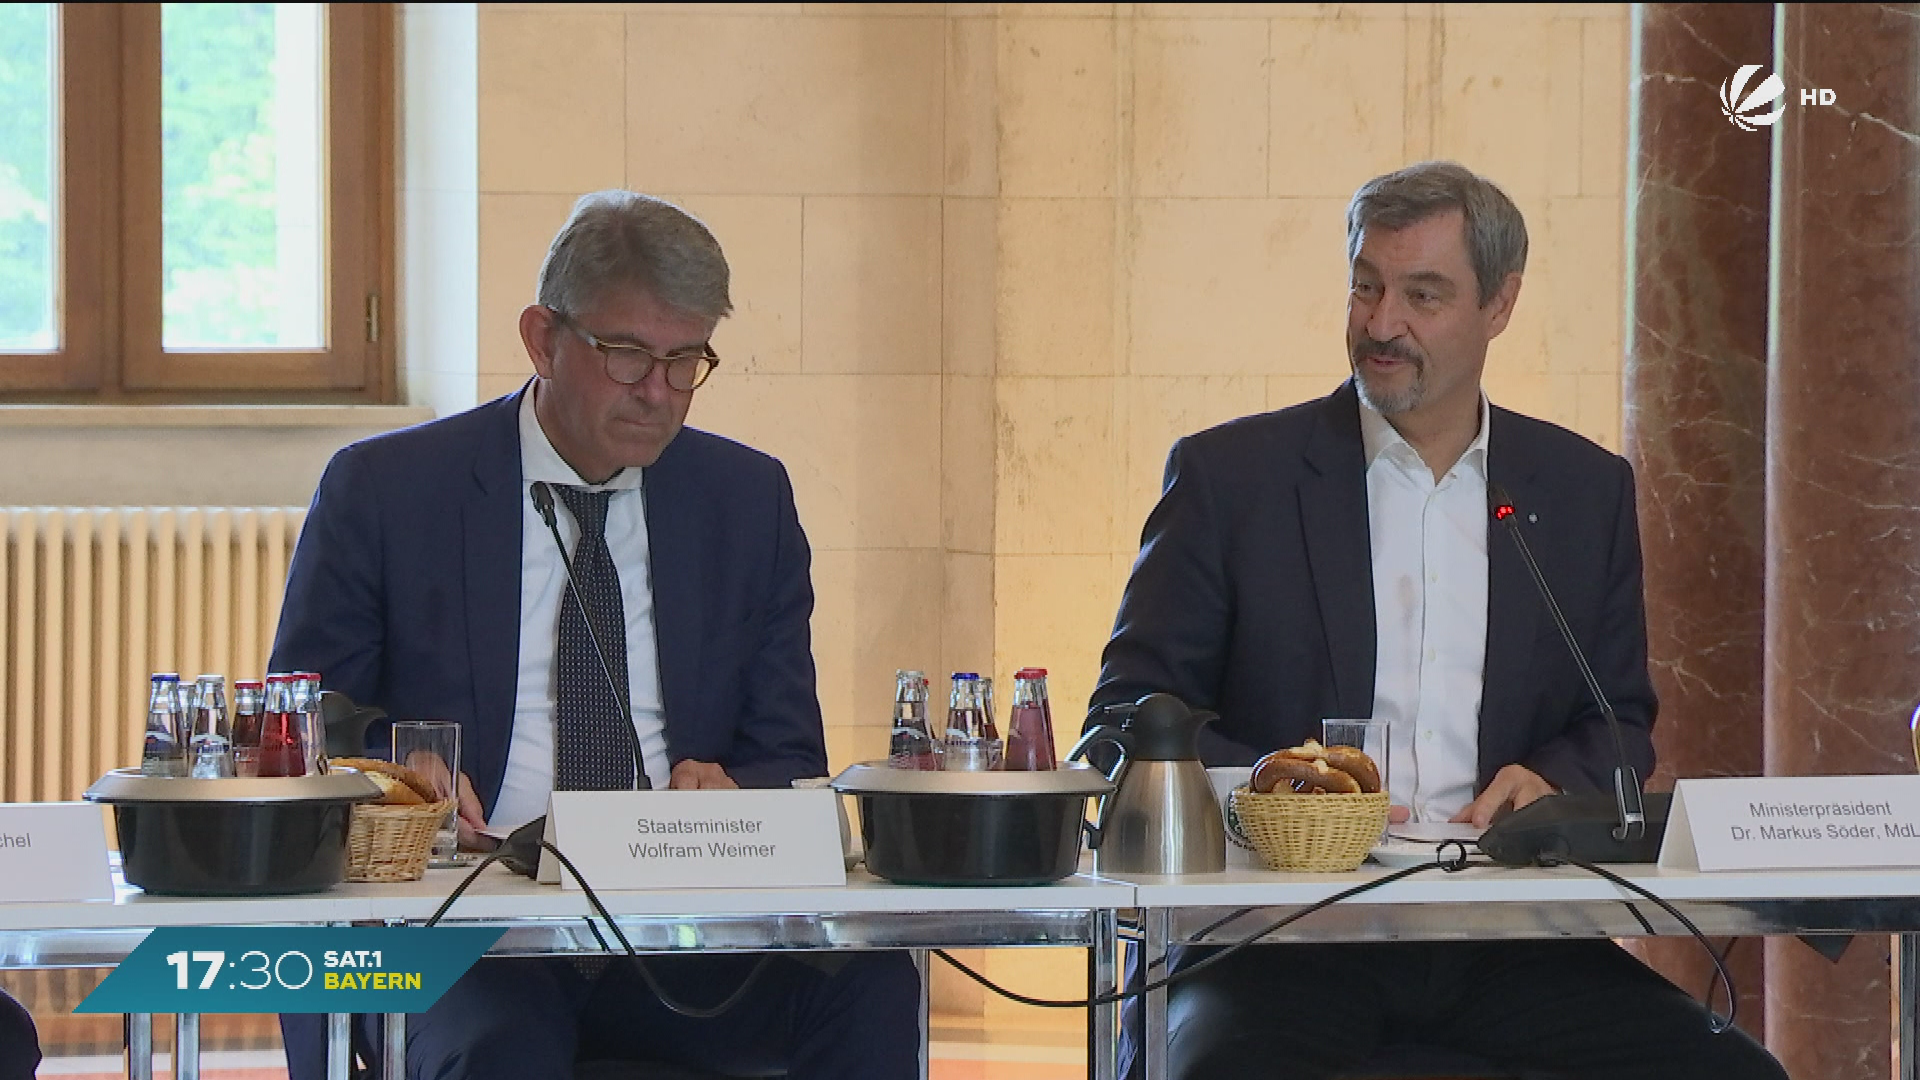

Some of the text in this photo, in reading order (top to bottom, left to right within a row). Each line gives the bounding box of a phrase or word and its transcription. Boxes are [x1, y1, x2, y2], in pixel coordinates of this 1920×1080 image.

[1749, 801, 1892, 819] Ministerpräsident
[637, 819, 763, 834] Staatsminister
[1731, 823, 1920, 840] Dr. Markus Söder, MdL
[629, 842, 776, 858] Wolfram Weimer
